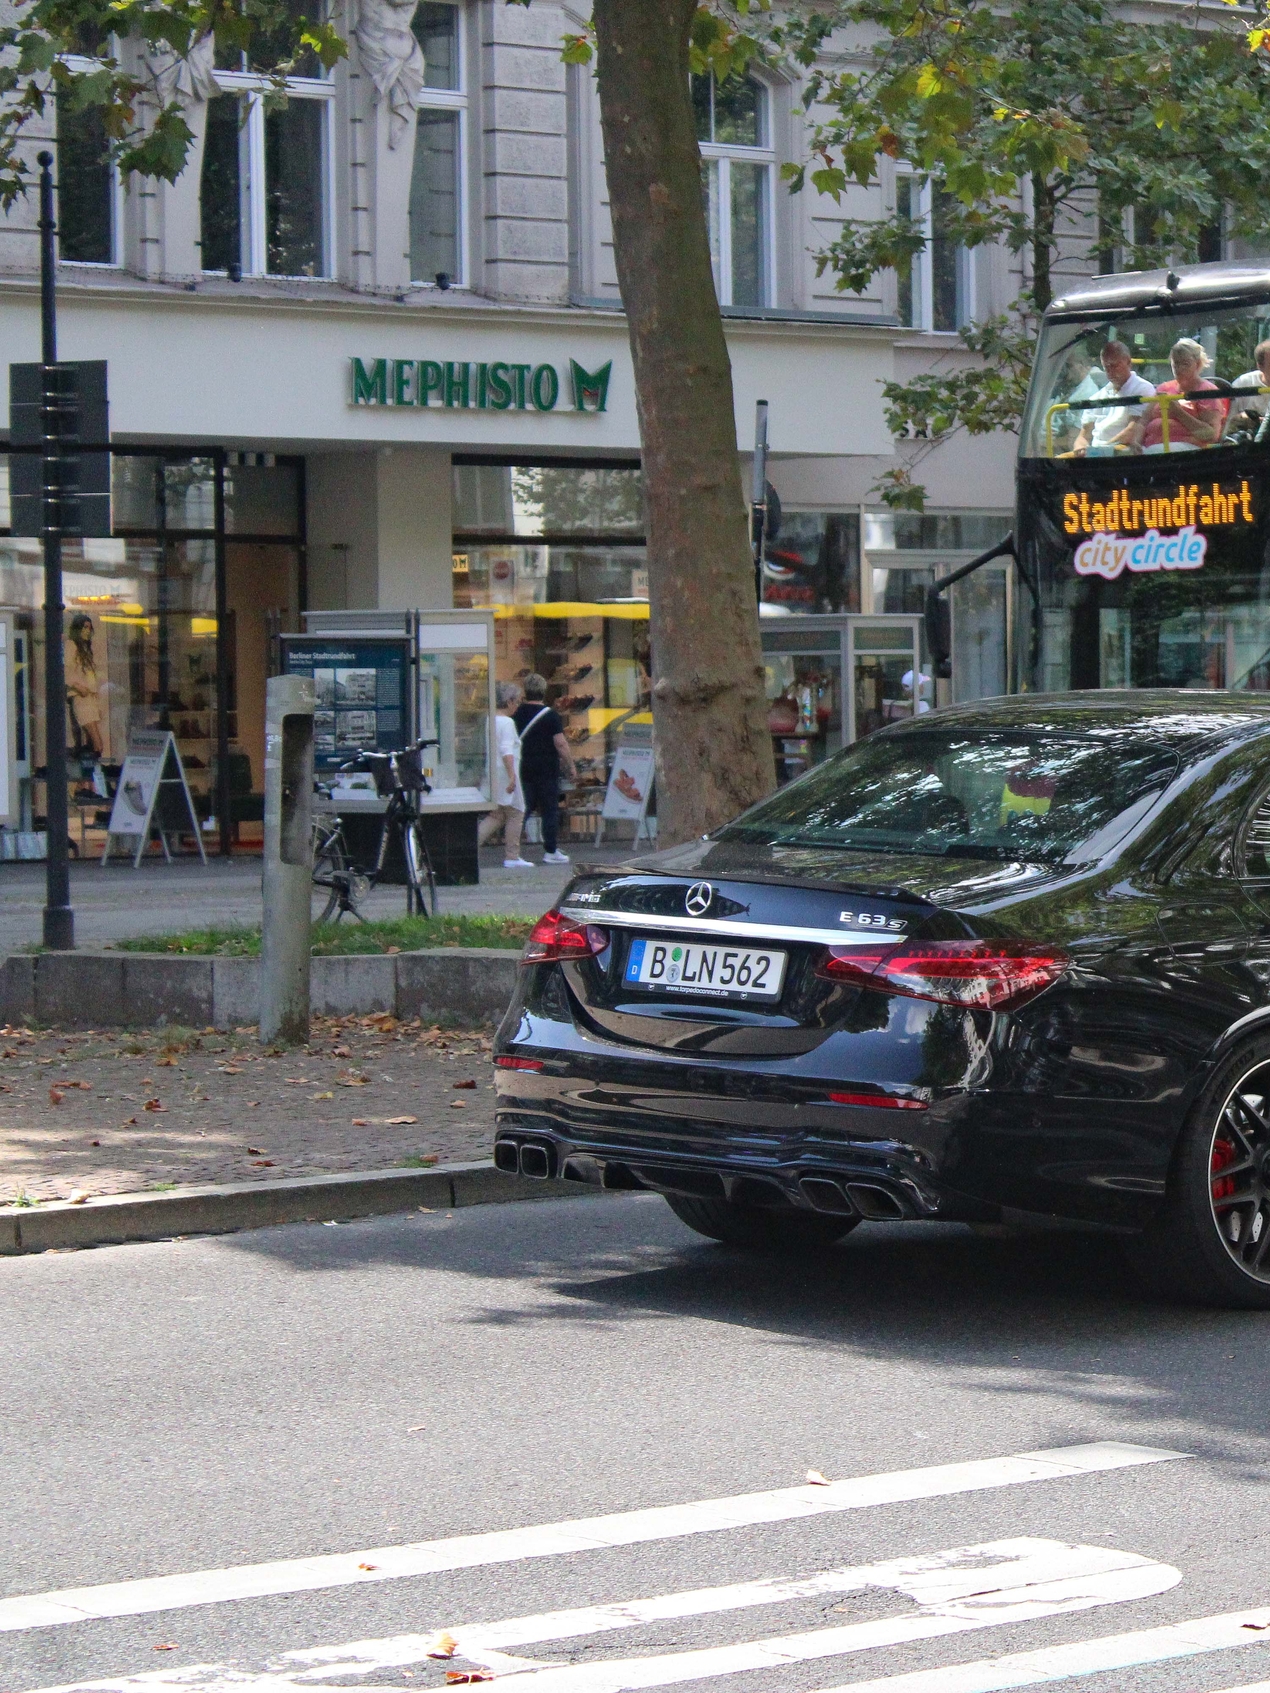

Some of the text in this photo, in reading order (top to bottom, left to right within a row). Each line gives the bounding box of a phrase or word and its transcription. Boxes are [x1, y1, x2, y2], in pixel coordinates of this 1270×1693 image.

[349, 357, 559, 411] MEPHISTO
[1063, 480, 1254, 534] Stadtrundfahrt
[1078, 533, 1202, 572] city circle
[289, 651, 356, 660] Berliner Stadtrundfahrt
[839, 910, 854, 923] E
[631, 964, 638, 975] D
[649, 946, 668, 979] B
[665, 984, 729, 998] www.torpedoconnect.de
